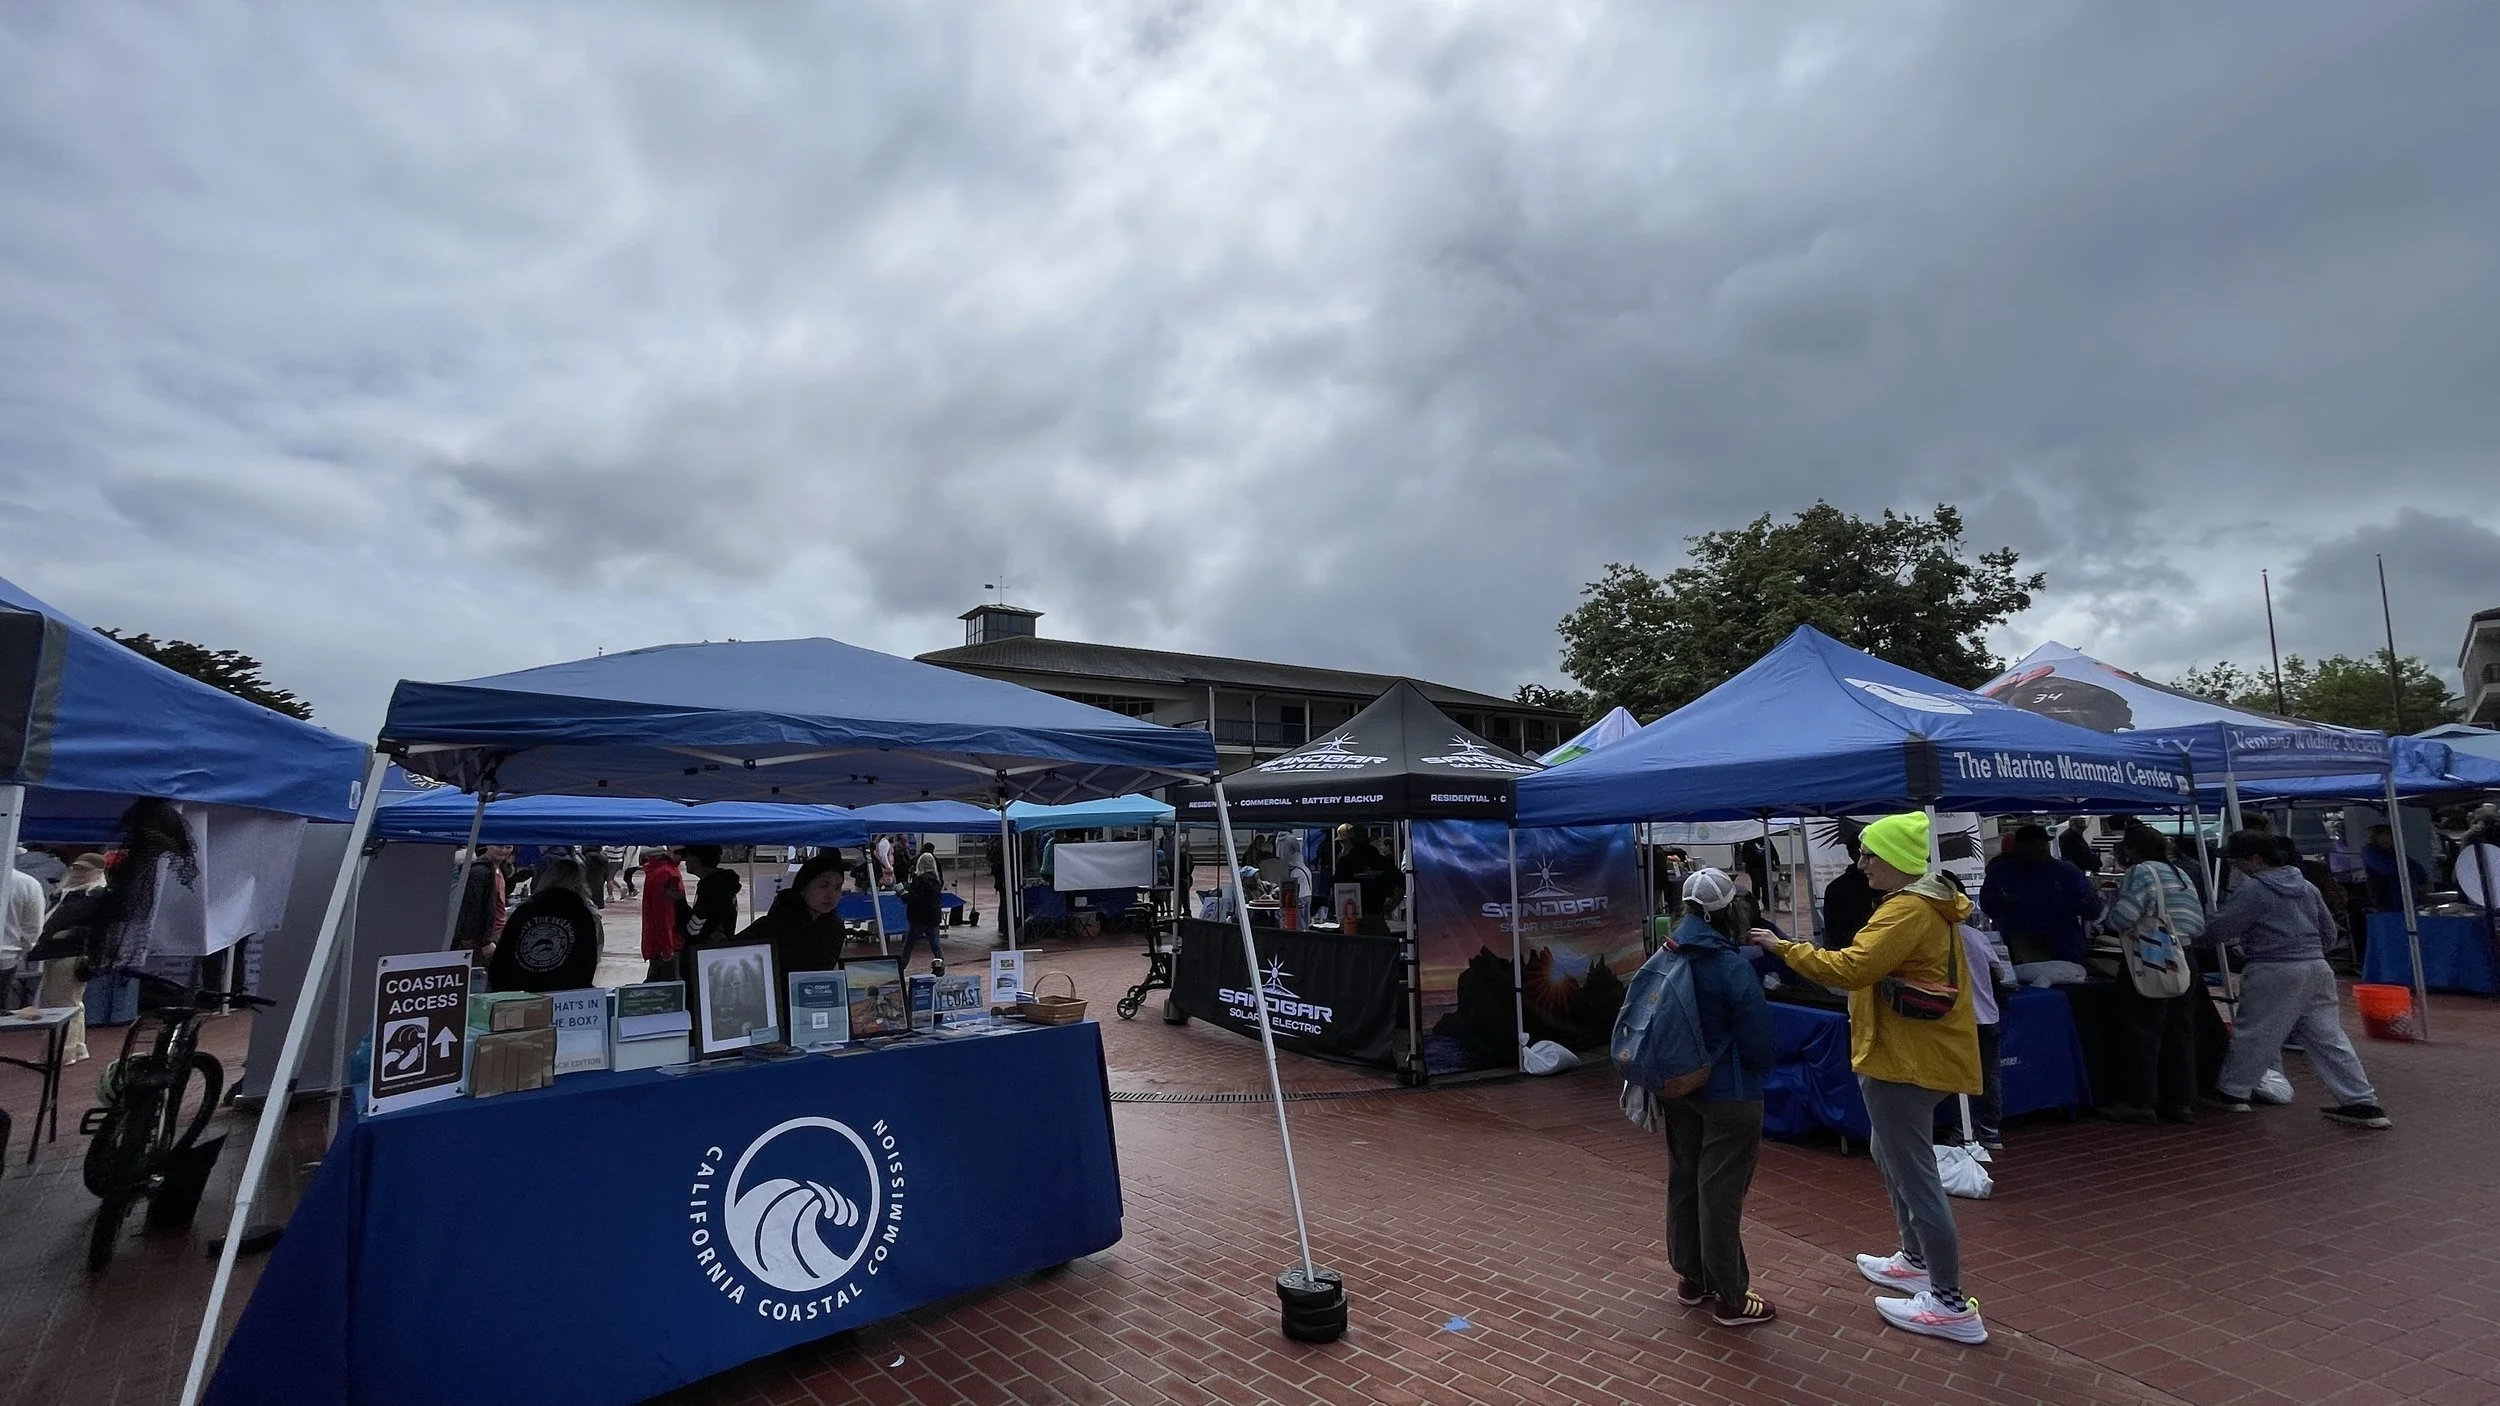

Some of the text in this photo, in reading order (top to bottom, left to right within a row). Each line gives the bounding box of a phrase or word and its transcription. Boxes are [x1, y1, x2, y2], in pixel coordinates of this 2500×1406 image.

[2032, 692, 2063, 704] 34
[2232, 731, 2291, 749] Ventana
[2294, 731, 2340, 751] Wildlife
[1953, 751, 2173, 788] The Marine Mammal Center
[1189, 795, 1384, 808] RESIDENAL COMMERCIAL BATTERY BACKUP
[1430, 794, 1490, 803] RESIDENTIAL
[1552, 916, 1601, 930] ELECTRIC
[386, 973, 464, 994] COASTAL
[389, 993, 458, 1015] ACCESS
[555, 999, 599, 1012] HAT'S IN
[946, 988, 981, 1008] COAST
[1219, 988, 1333, 1023] SANDBAR
[553, 1015, 599, 1028] HE BOX?
[1272, 1017, 1322, 1035] ELECTRIC
[571, 1057, 601, 1068] EDITION
[2000, 1056, 2018, 1067] enter
[689, 1119, 905, 1321] CALIFORNIA COASTAL COMMISSION
